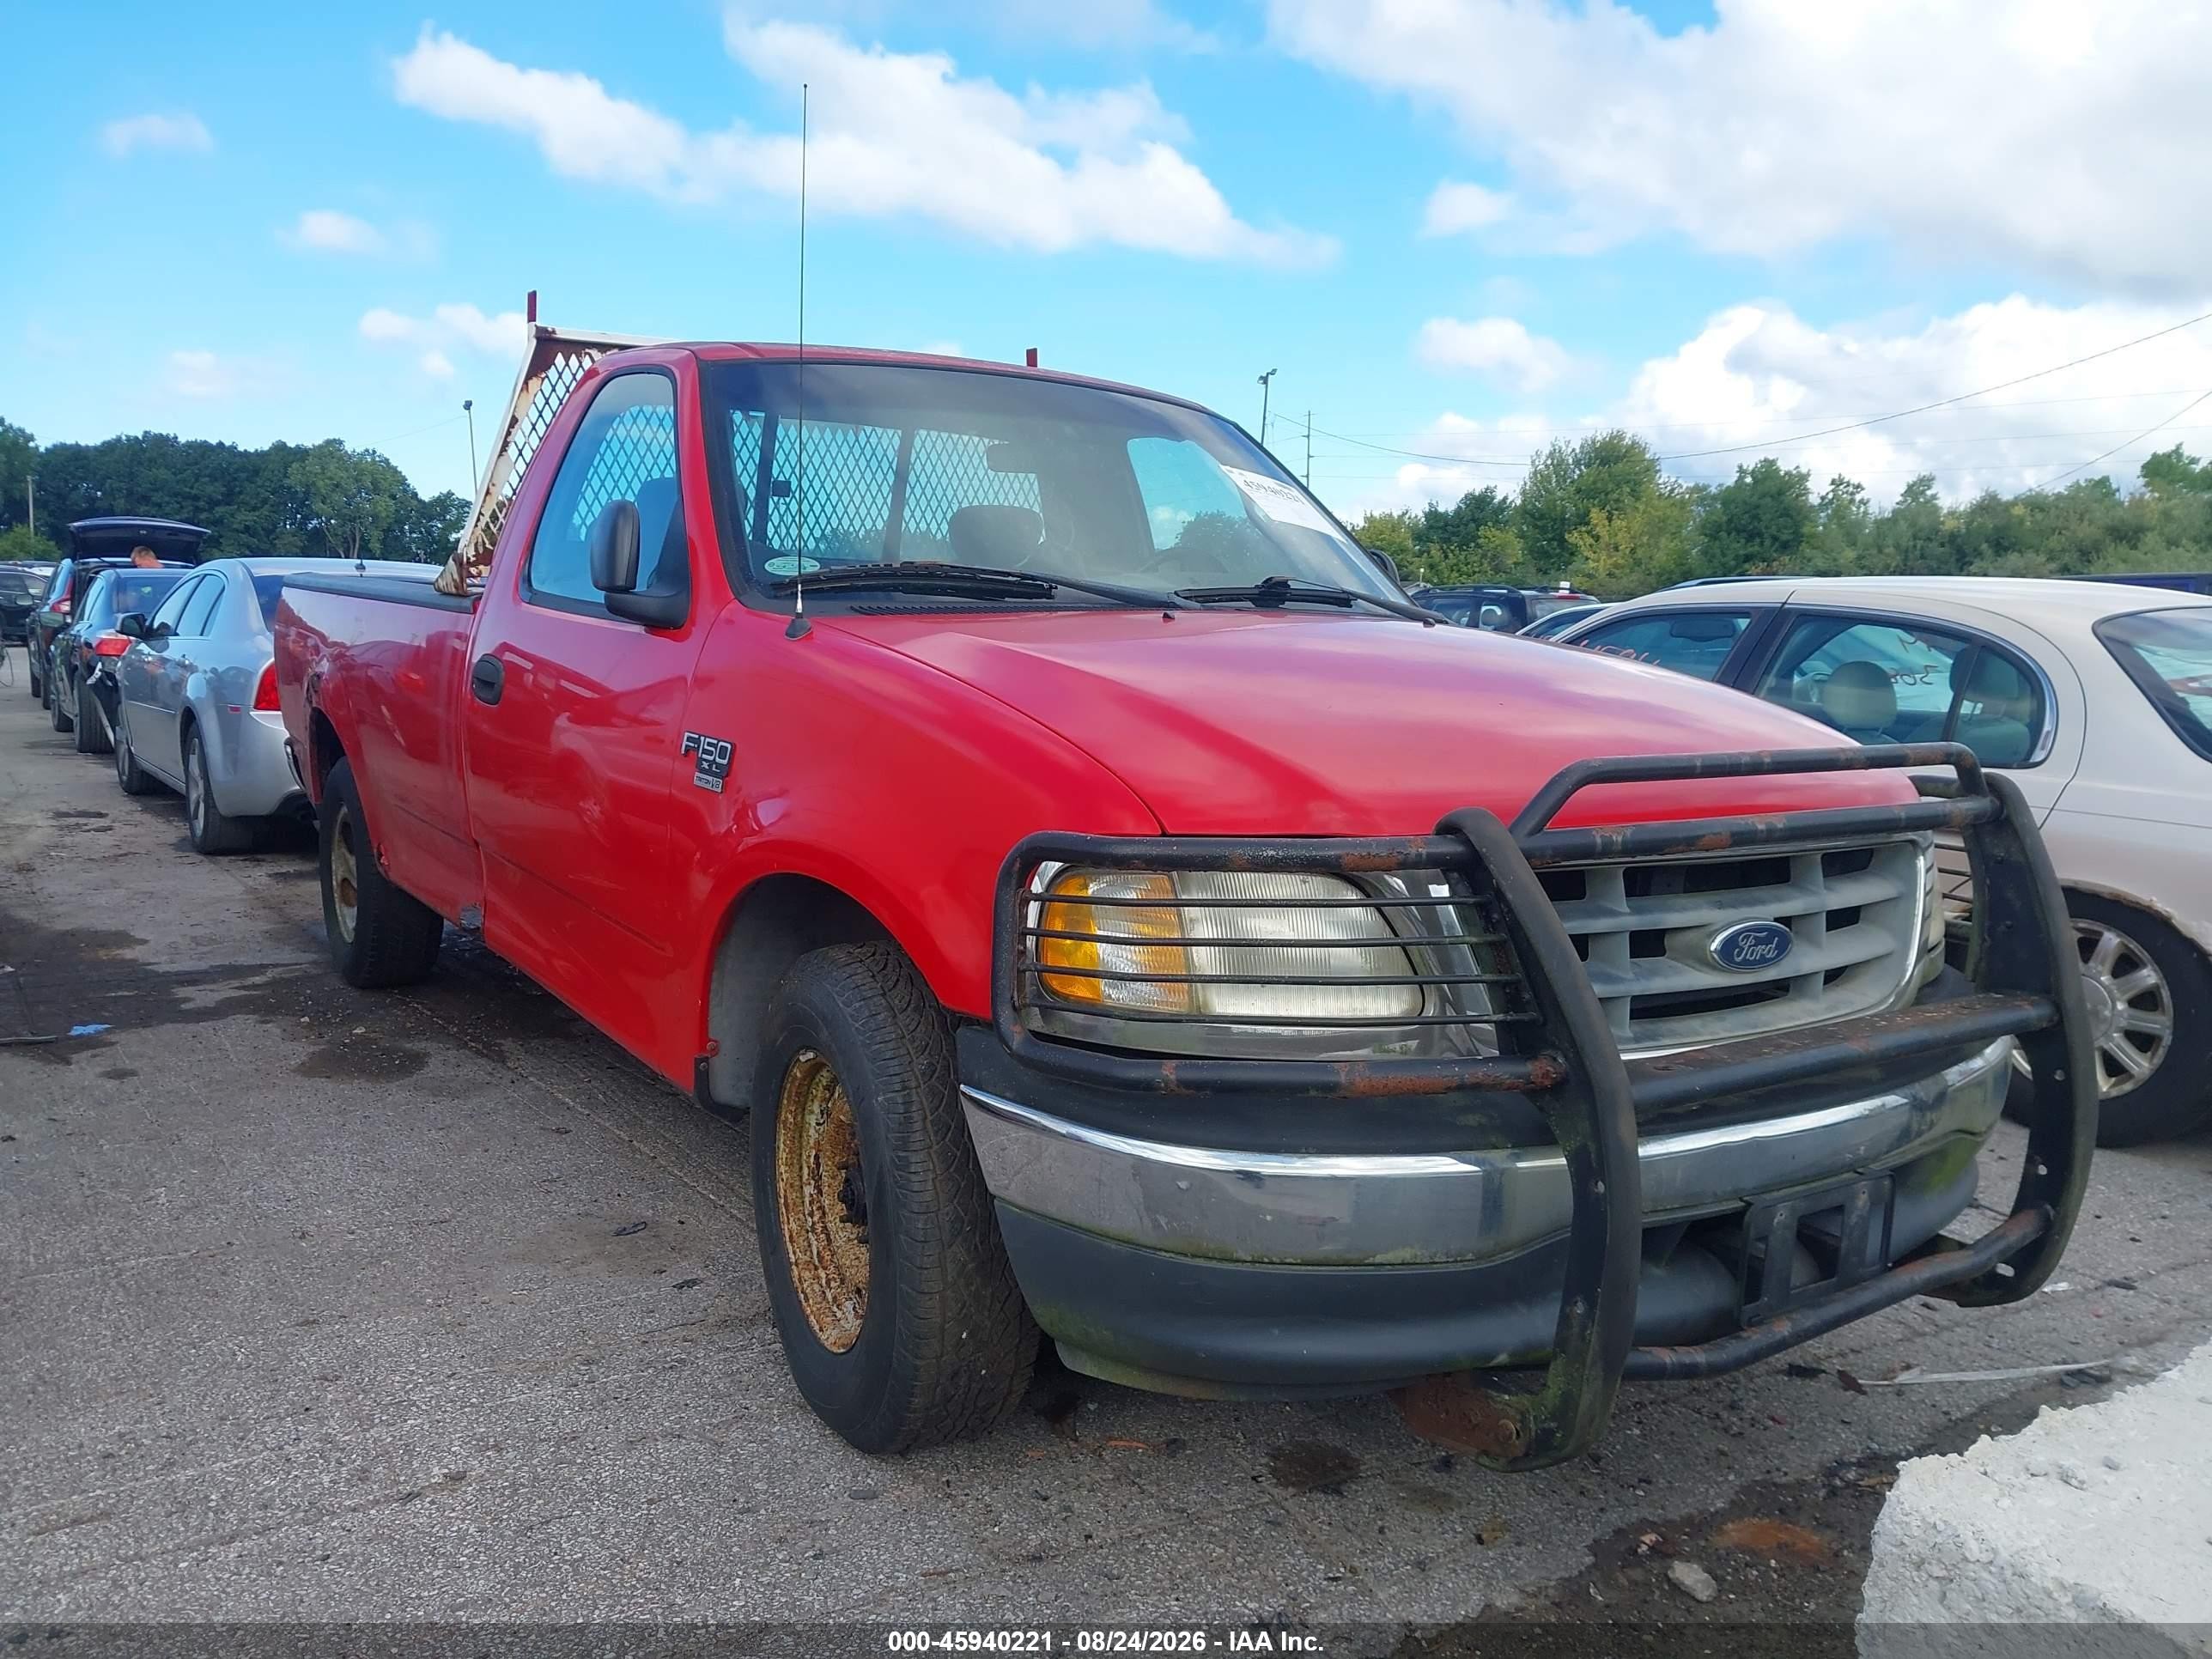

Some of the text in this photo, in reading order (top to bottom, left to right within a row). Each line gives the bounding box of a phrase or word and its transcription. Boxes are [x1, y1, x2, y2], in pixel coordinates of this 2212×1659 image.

[701, 761, 720, 772] XL
[711, 777, 721, 790] V8
[1734, 931, 1779, 962] Ford
